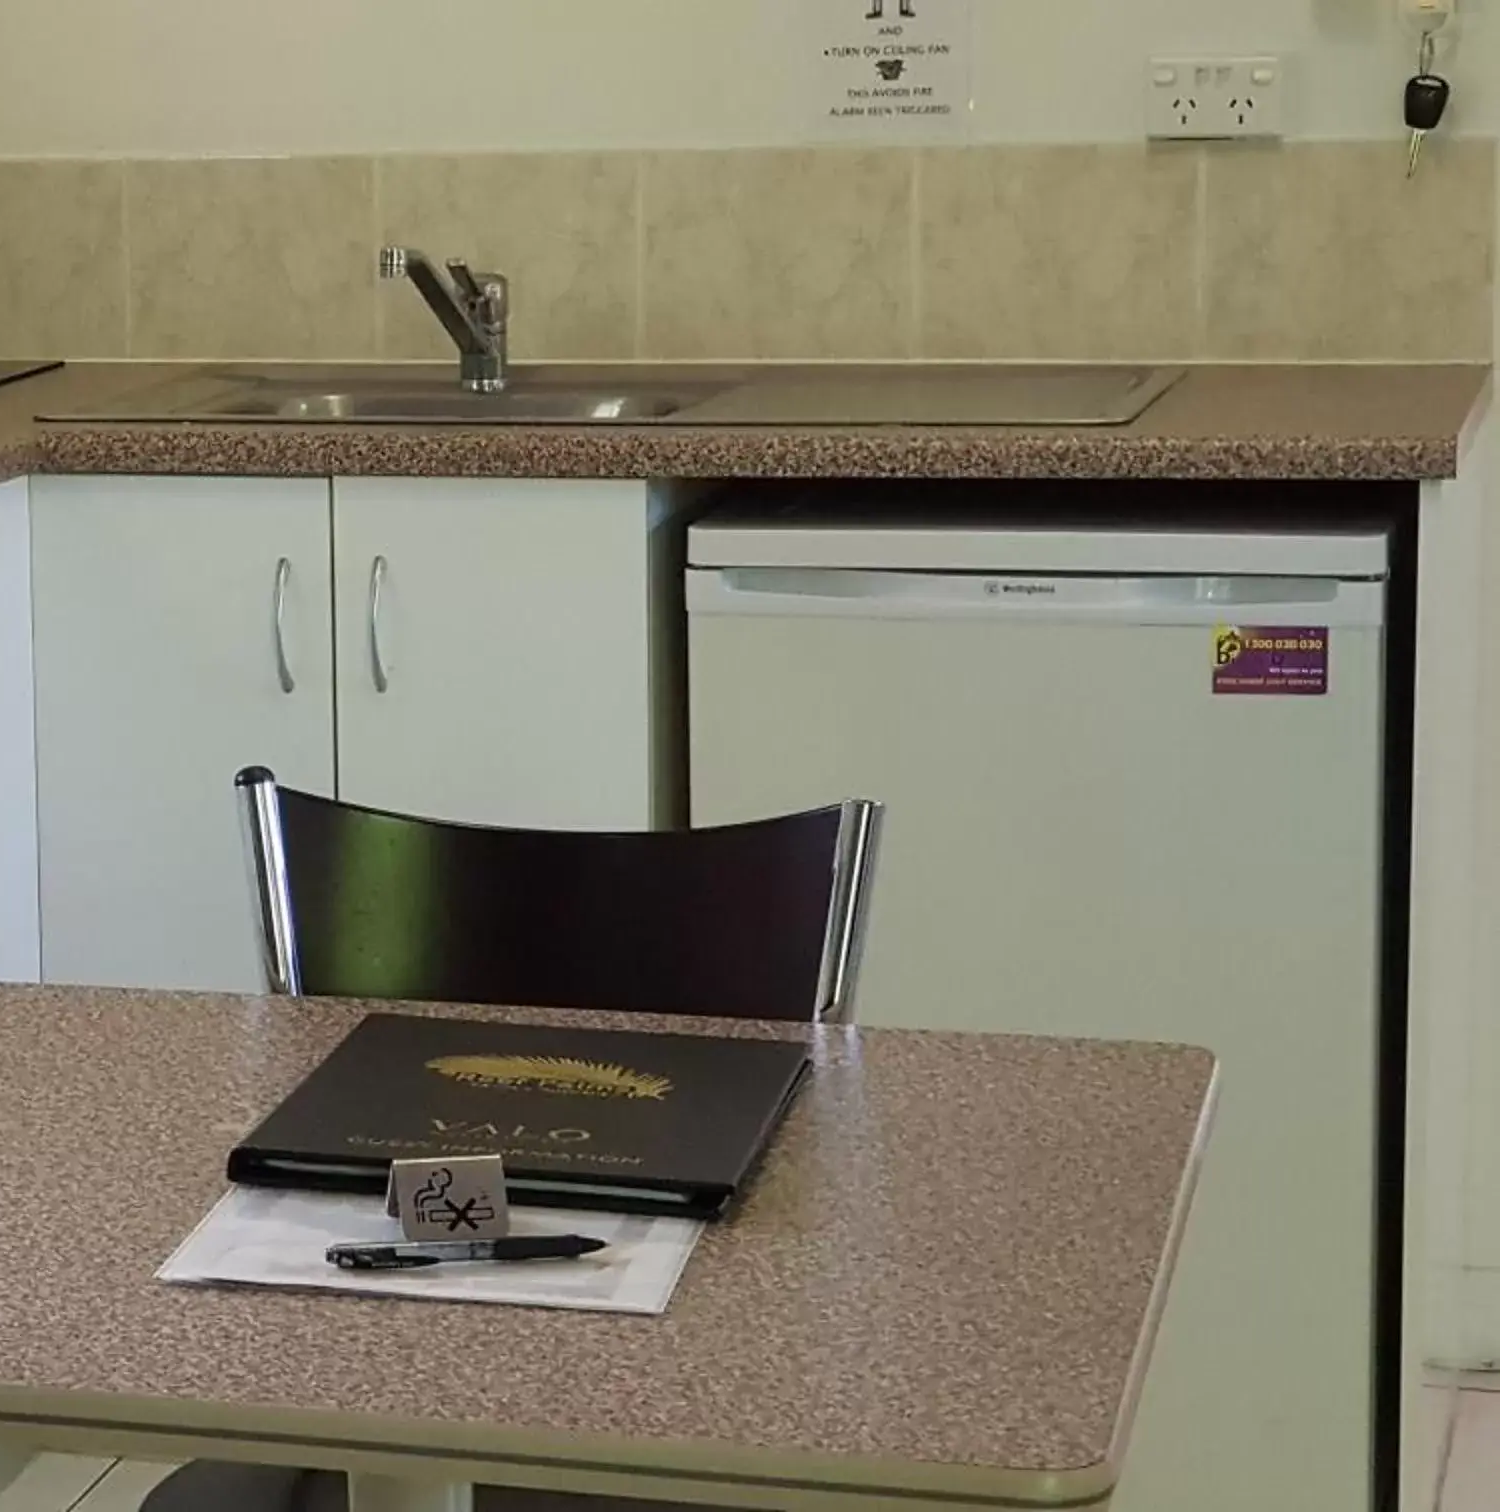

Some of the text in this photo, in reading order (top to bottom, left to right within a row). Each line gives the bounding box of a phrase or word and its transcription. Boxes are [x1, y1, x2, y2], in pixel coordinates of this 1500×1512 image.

[878, 26, 903, 36] AND
[832, 46, 860, 57] TURN
[863, 45, 881, 56] ON
[927, 44, 950, 54] FAN
